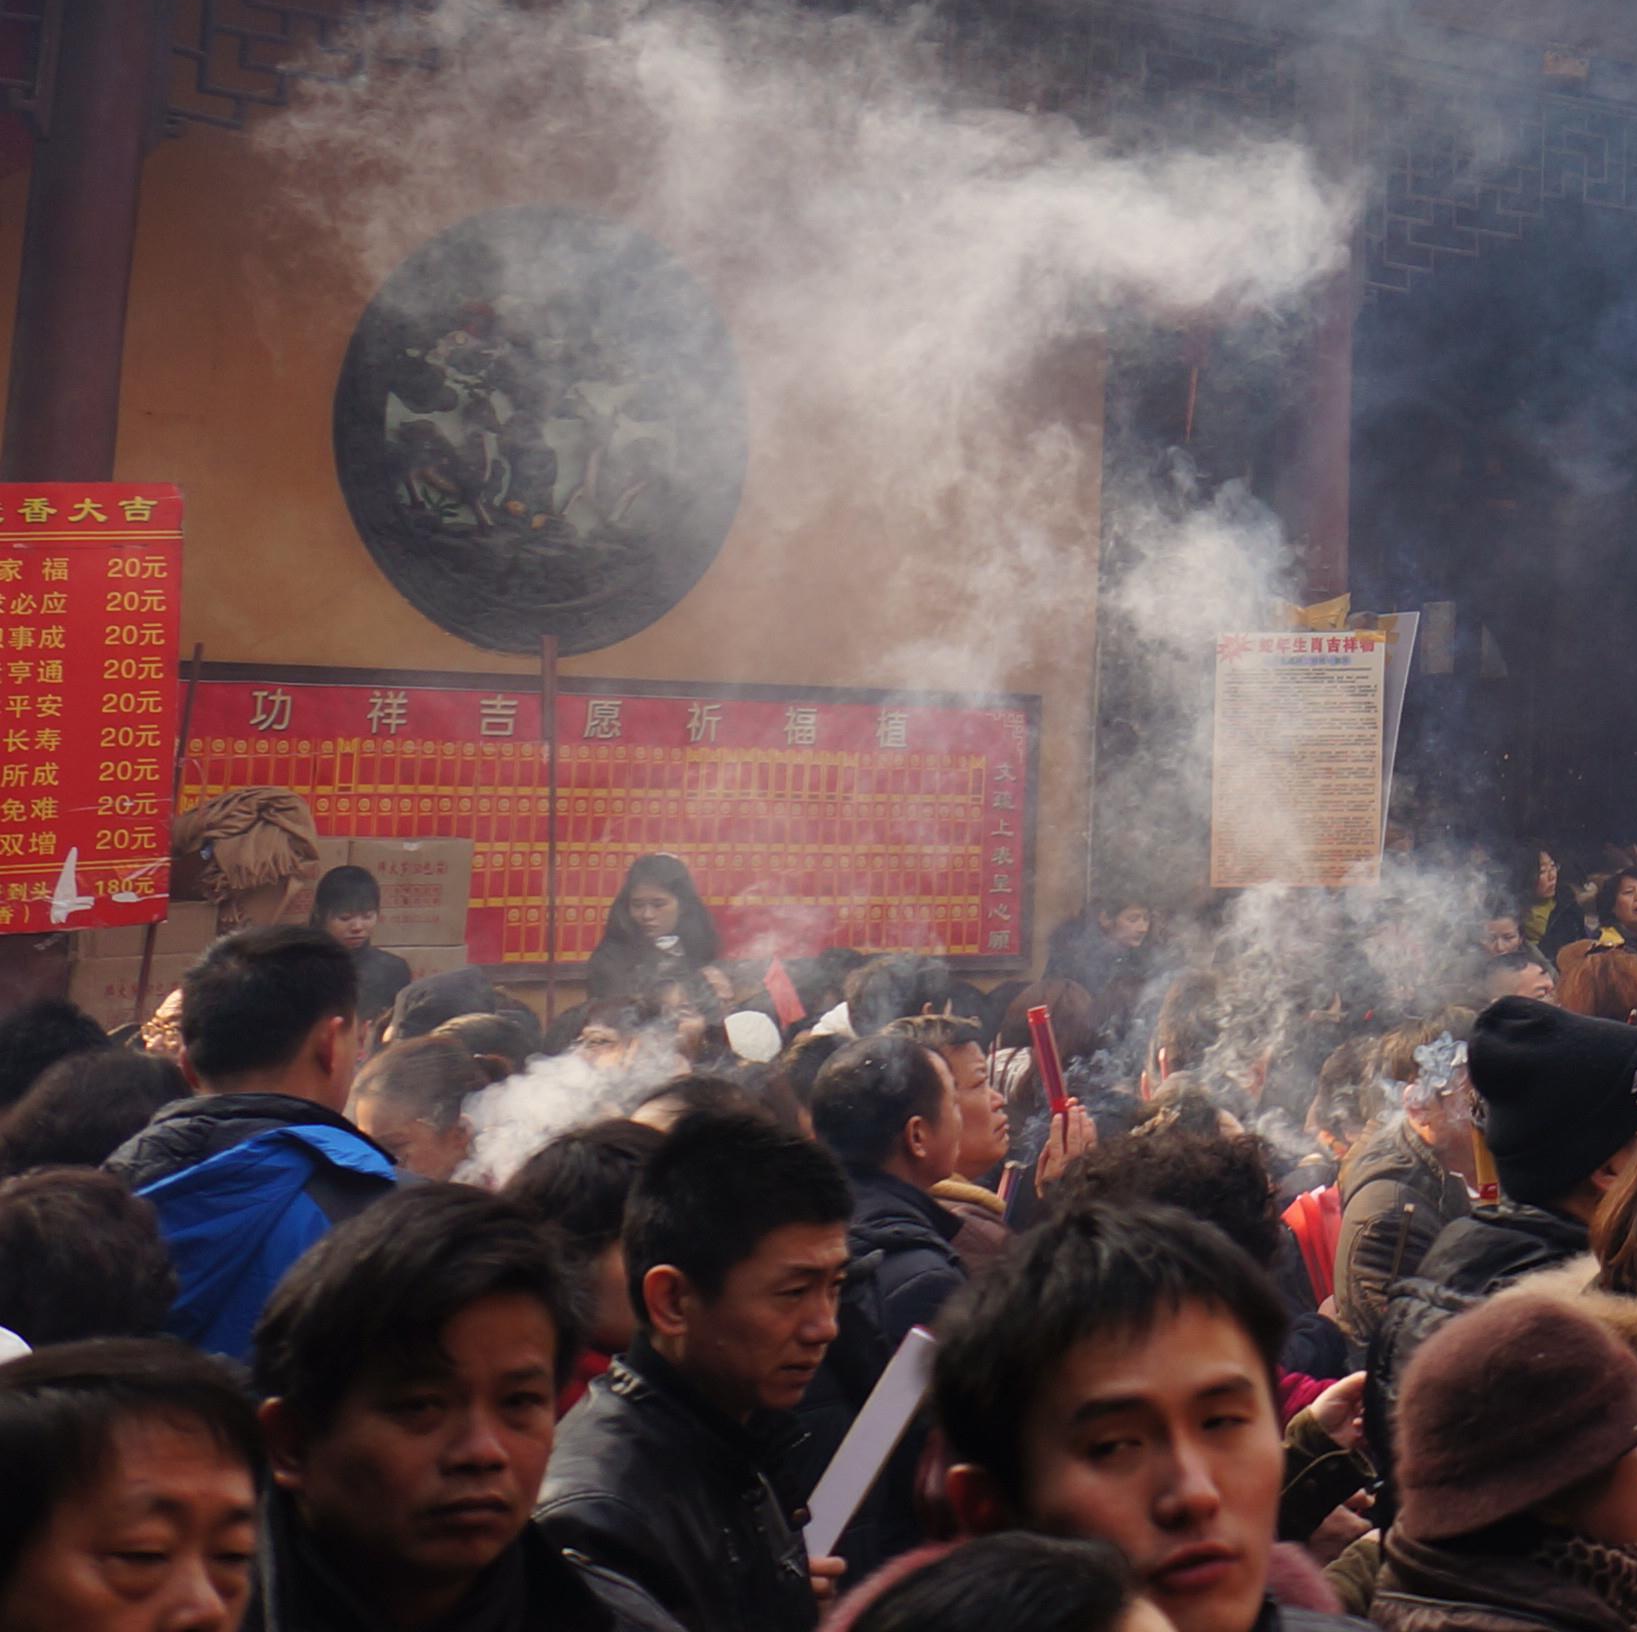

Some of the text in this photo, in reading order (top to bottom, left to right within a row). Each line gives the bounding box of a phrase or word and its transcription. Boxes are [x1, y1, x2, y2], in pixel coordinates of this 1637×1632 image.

[0, 496, 158, 523] 香大吉
[107, 556, 168, 578] 20元
[0, 589, 167, 615] 必应 20元
[0, 623, 165, 650] 事成 20元
[0, 657, 164, 684] 亨通 20元
[101, 691, 163, 713] 20元
[100, 725, 161, 747] 20元
[98, 759, 160, 781] 20元
[97, 793, 158, 816] 20元
[95, 827, 157, 850] 20元
[0, 878, 155, 900] 到头 180元
